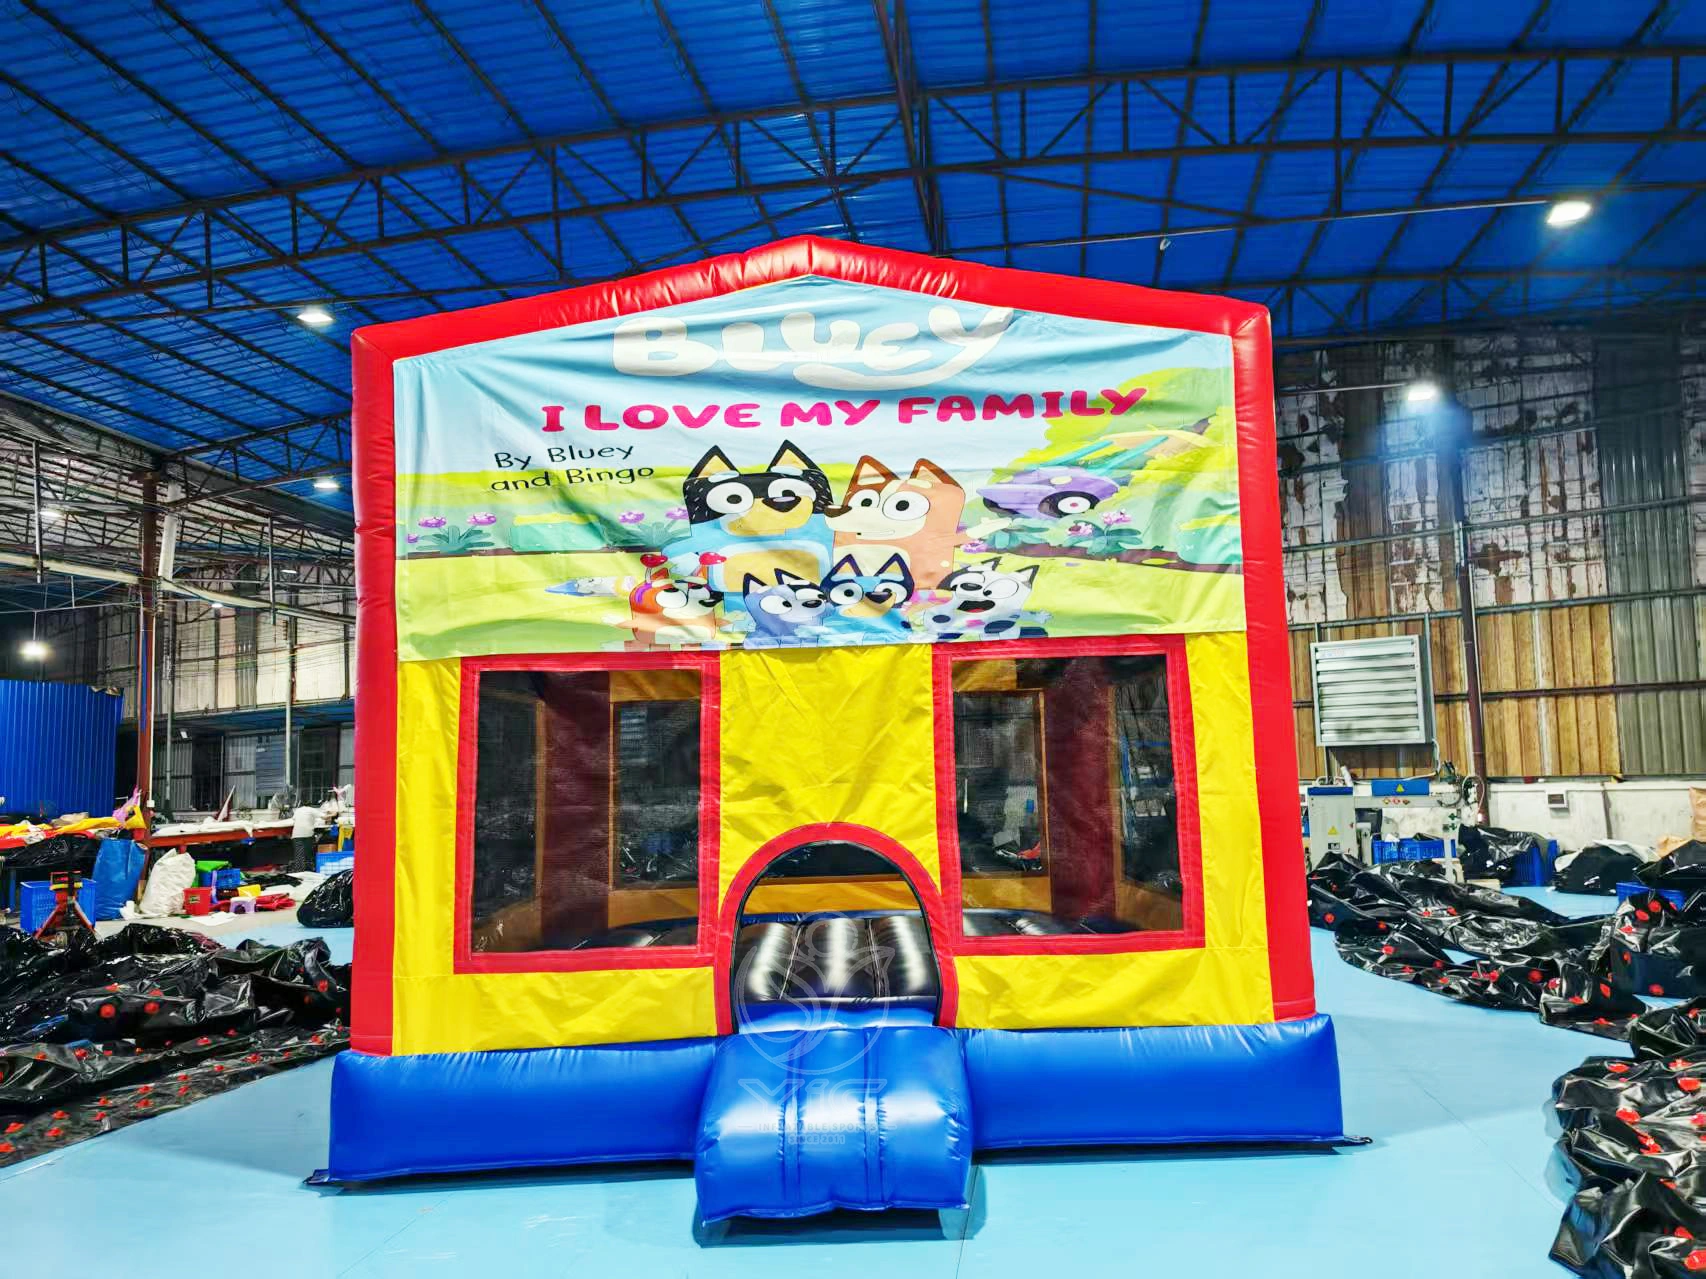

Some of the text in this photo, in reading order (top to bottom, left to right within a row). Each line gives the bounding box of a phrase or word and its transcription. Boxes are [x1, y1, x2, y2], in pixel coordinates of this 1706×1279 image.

[542, 388, 1146, 432] I LOVE MY FAMILY
[494, 445, 634, 470] By Bluey
[491, 467, 655, 491] and Bingo
